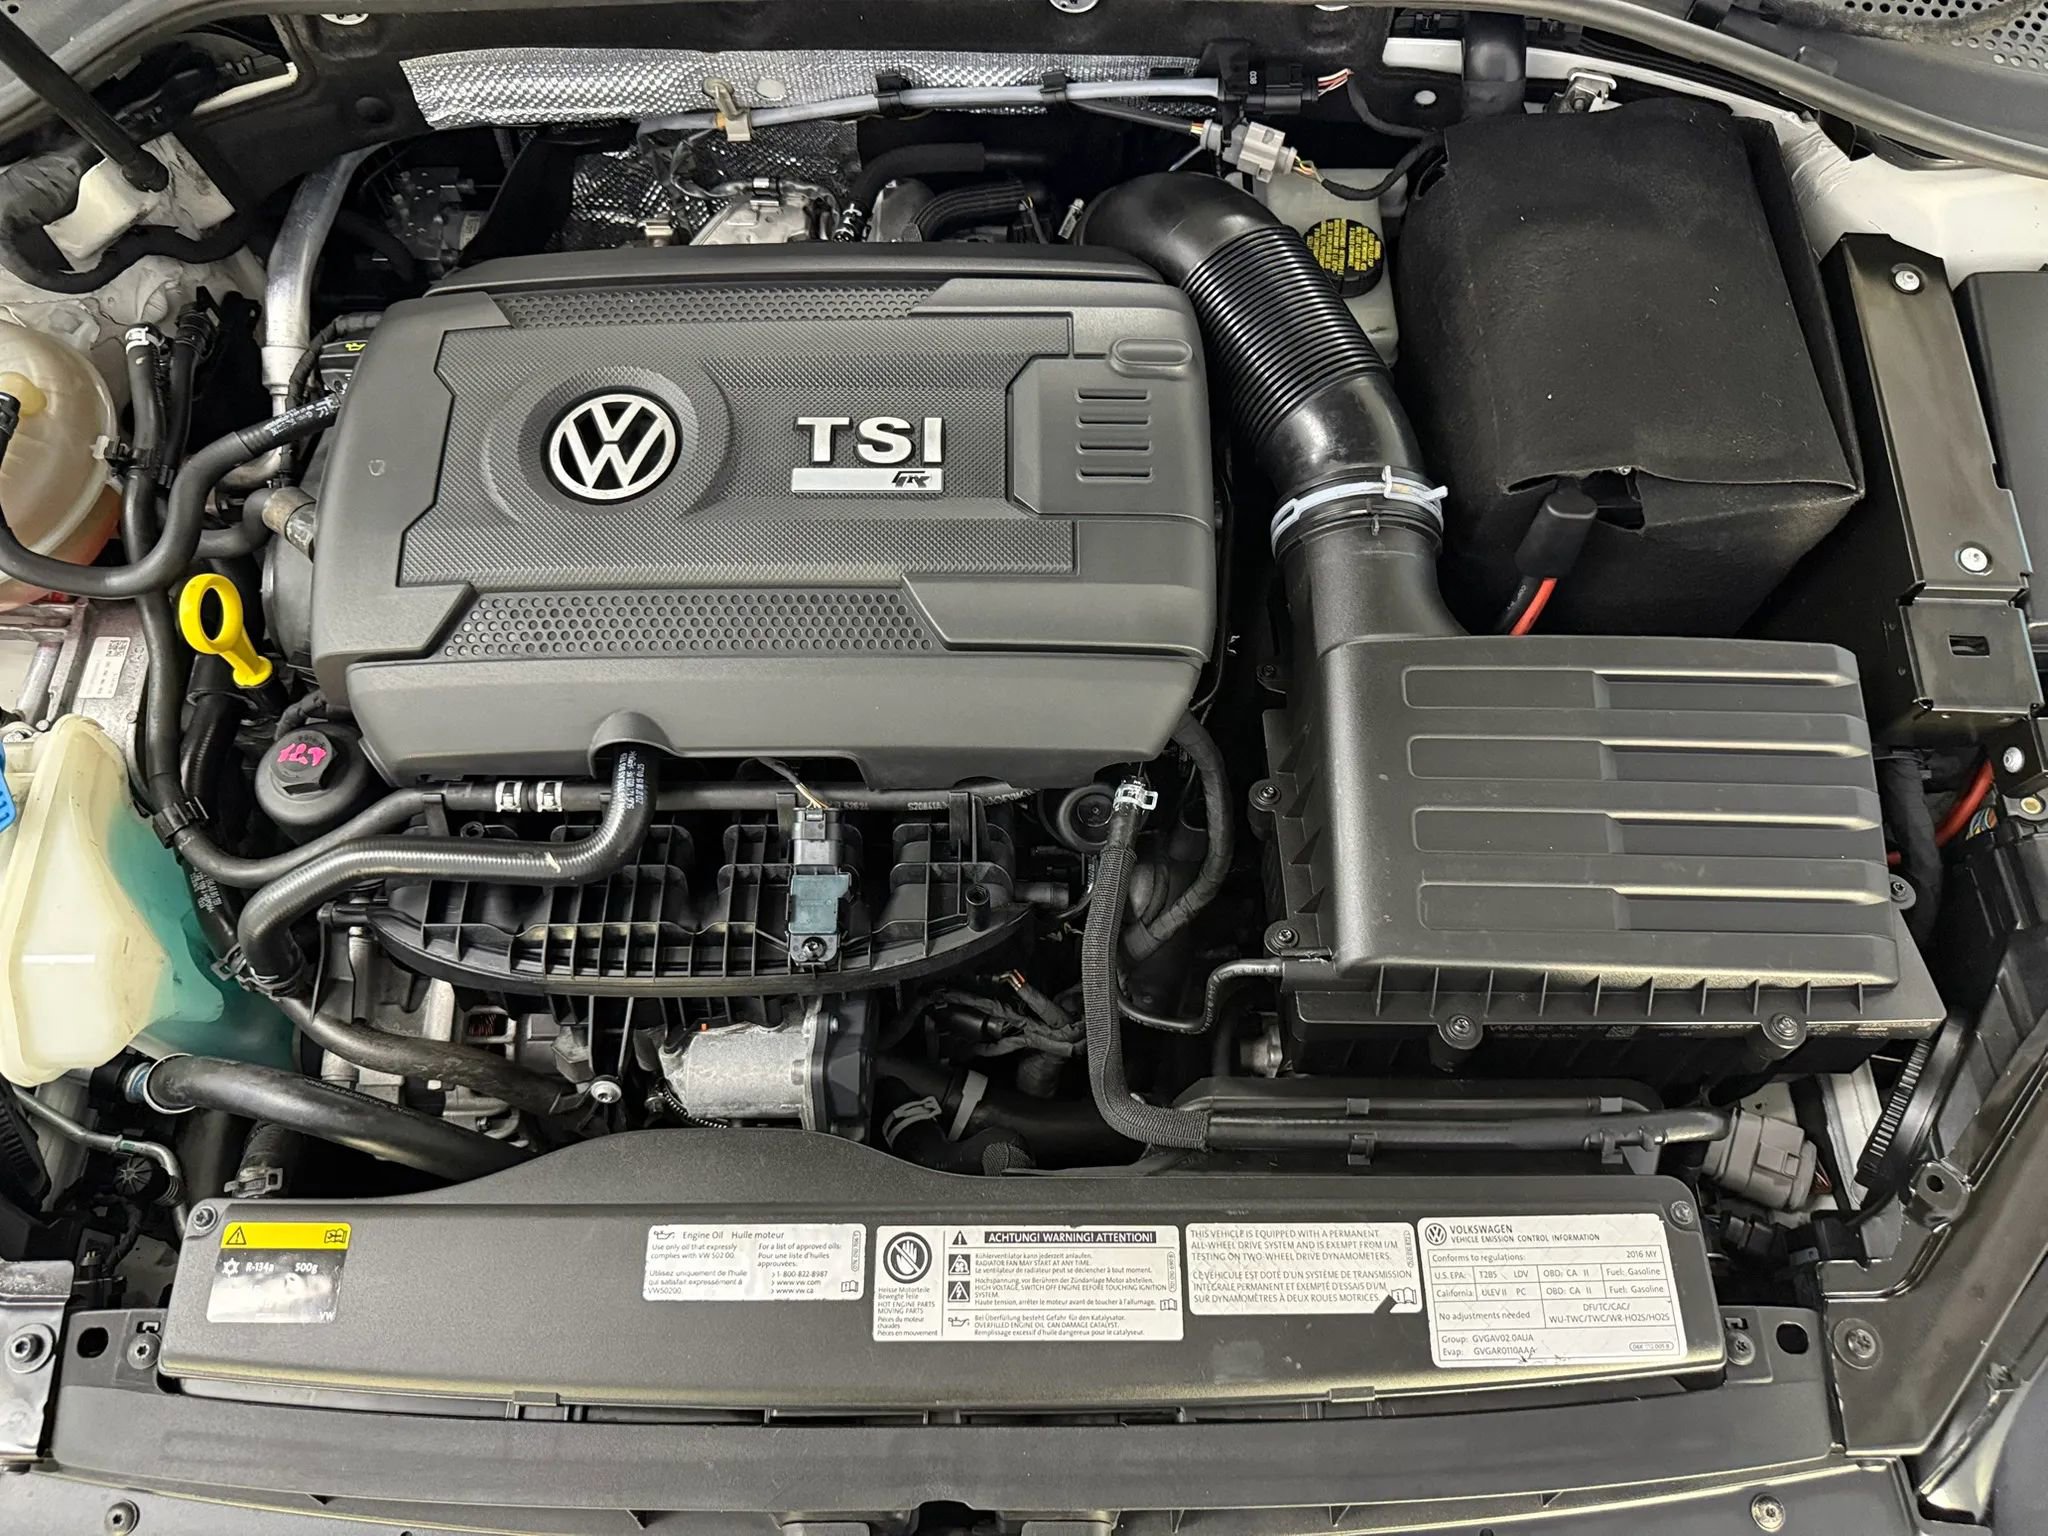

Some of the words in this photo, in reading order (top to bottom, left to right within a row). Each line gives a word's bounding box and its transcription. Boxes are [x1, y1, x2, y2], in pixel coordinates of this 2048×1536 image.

[797, 416, 942, 464] TSI
[549, 393, 676, 500] VW
[1449, 1224, 1513, 1234] VOLKSWAGEN
[682, 1231, 710, 1241] Engine
[712, 1231, 724, 1239] Oil
[731, 1231, 753, 1239] Huile
[754, 1231, 784, 1239] moteur
[988, 1232, 1040, 1242] ACHTUNG!
[1042, 1232, 1094, 1242] WARNING!
[1095, 1232, 1153, 1242] ATTENTION!
[1191, 1229, 1209, 1238] THIS
[1210, 1229, 1244, 1238] VEHICLE
[1246, 1229, 1253, 1238] IS
[1255, 1229, 1296, 1239] EQUIPPED
[1297, 1229, 1320, 1238] WITH
[1321, 1229, 1328, 1238] A
[1329, 1229, 1379, 1238] PERMANENT
[1451, 1235, 1479, 1244] VEHICLE
[1481, 1235, 1514, 1243] EMISSION
[1517, 1234, 1549, 1242] CONTROL
[1552, 1233, 1600, 1242] INFORMATION
[665, 1243, 680, 1252] only
[706, 1243, 737, 1252] expressly
[796, 1243, 827, 1251] approved
[1191, 1241, 1236, 1249] ALL-WHEEL
[1238, 1241, 1261, 1249] DRIVE
[1264, 1241, 1295, 1249] SYSTEM
[1296, 1241, 1315, 1249] AND
[1317, 1241, 1324, 1249] IS
[1326, 1241, 1356, 1249] EXEMPT
[1359, 1241, 1382, 1249] FROM
[1384, 1241, 1398, 1249] I/M
[650, 1252, 680, 1260] complies
[1192, 1252, 1226, 1261] TESTING
[1227, 1252, 1240, 1261] ON
[1242, 1252, 1295, 1261] TWO-WHEEL
[1296, 1252, 1322, 1261] DRIVE
[1432, 1254, 1469, 1262] Conforms
[1481, 1253, 1526, 1263] regulations:
[1626, 1250, 1643, 1258] 2016
[1645, 1250, 1657, 1258] MY
[245, 1262, 275, 1272] R-134a
[294, 1262, 318, 1275] 500g
[1566, 1269, 1578, 1277] CA
[1584, 1269, 1589, 1277] II
[1606, 1268, 1625, 1276] Fuel:
[1627, 1267, 1661, 1275] Gasoline
[675, 1270, 716, 1278] uniquement
[1193, 1271, 1203, 1279] CE
[1244, 1271, 1258, 1279] EST
[1283, 1271, 1304, 1279] D'UN
[1340, 1271, 1351, 1279] DE
[1352, 1270, 1412, 1278] TRANSMISSION
[1479, 1271, 1498, 1279] T2B5
[1513, 1270, 1529, 1278] LDV
[1237, 1282, 1284, 1291] PERMANENT
[1286, 1282, 1295, 1291] ET
[1331, 1282, 1365, 1290] D'ESSAIS
[1609, 1286, 1628, 1294] Fuel:
[1630, 1285, 1664, 1293] Gasoline
[1481, 1289, 1501, 1297] ULEV
[1516, 1288, 1526, 1296] PC
[1194, 1294, 1210, 1303] SUR
[1279, 1292, 1285, 1302] À
[1286, 1294, 1309, 1302] DEUX
[1311, 1294, 1338, 1302] ROUES
[319, 1311, 335, 1321] VW
[1452, 1312, 1500, 1321] adjustments
[1502, 1311, 1530, 1319] needed
[1442, 1335, 1468, 1345] Group:
[1442, 1348, 1464, 1357] Evap:
